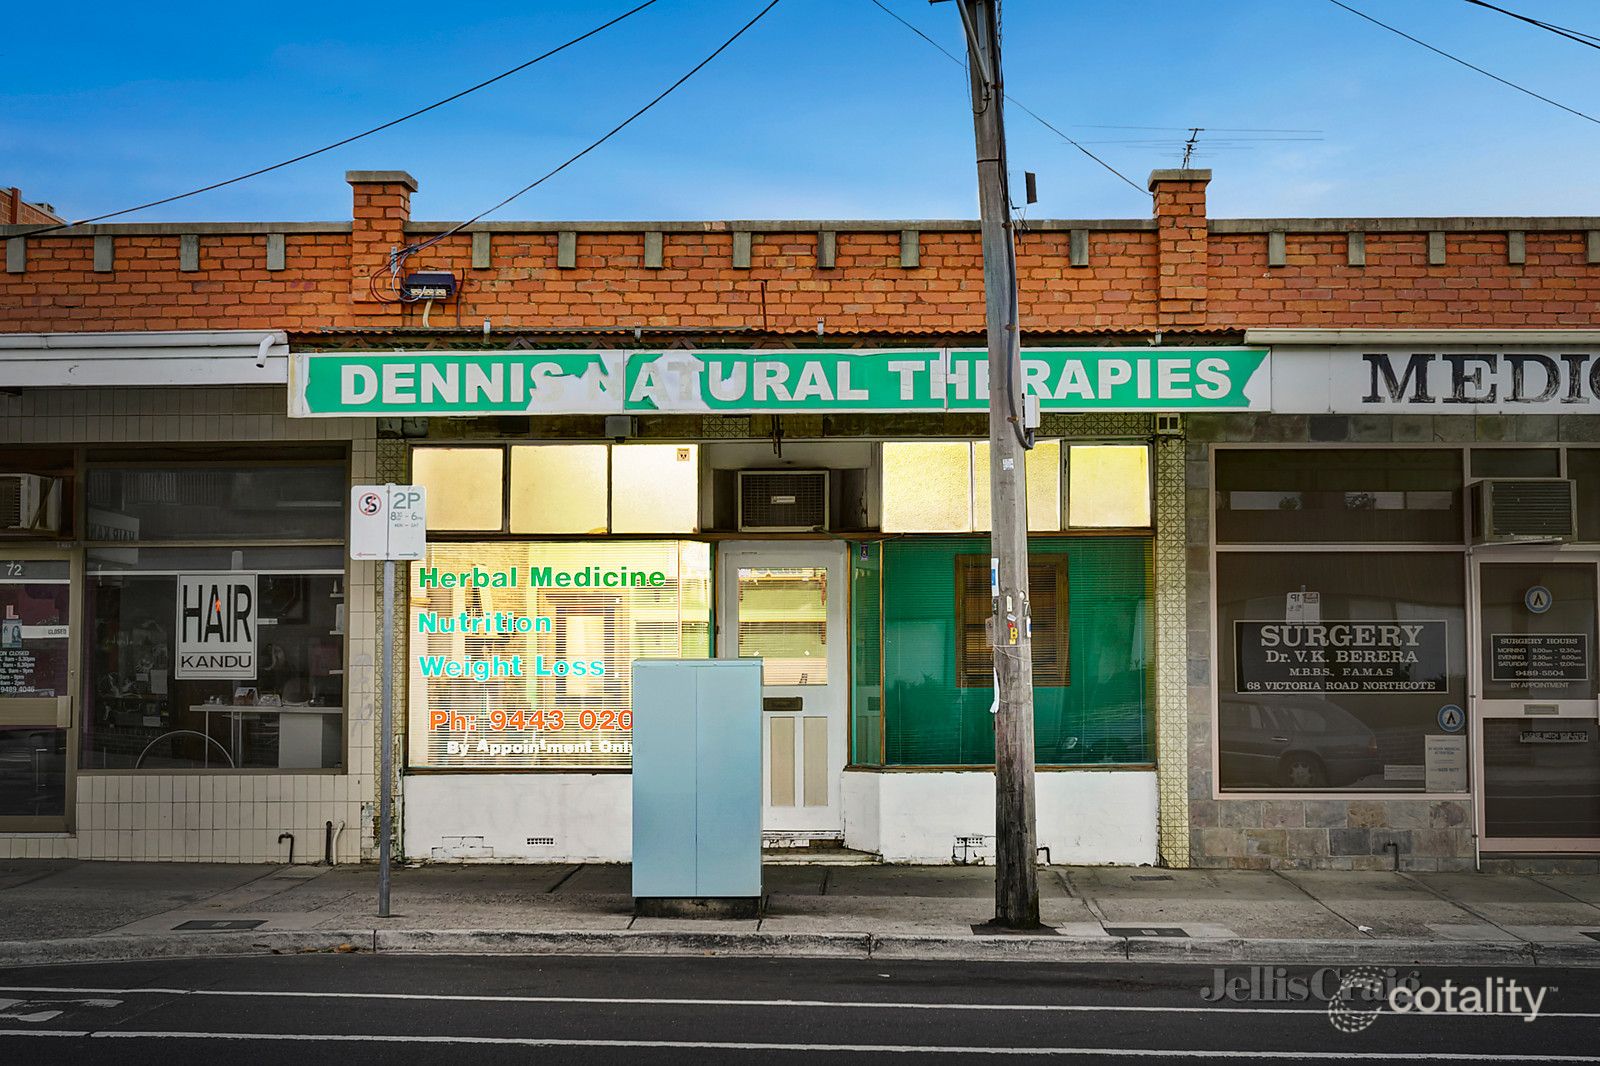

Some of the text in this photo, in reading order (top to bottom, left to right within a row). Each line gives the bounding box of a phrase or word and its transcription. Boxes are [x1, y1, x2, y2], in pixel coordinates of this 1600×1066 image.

[340, 362, 565, 405] DENNIS
[586, 360, 870, 403] NATURAL
[1361, 353, 1600, 404] MEDI
[392, 492, 421, 510] 2P
[6, 561, 22, 576] 72
[418, 566, 666, 588] Herbal Medicine
[181, 584, 252, 643] HAIR
[418, 612, 552, 633] Nutrition
[1260, 625, 1424, 647] SURGERY
[181, 656, 252, 668] KANDU
[1266, 650, 1291, 663] Dr.
[1335, 650, 1419, 663] BERERA
[419, 656, 606, 681] Weight Loss
[1246, 681, 1436, 691] 68 VICTORIA ROAD NORTHCOTE
[430, 709, 633, 731] Ph: 9443 020
[446, 740, 469, 757] By
[476, 738, 592, 756] Appointment
